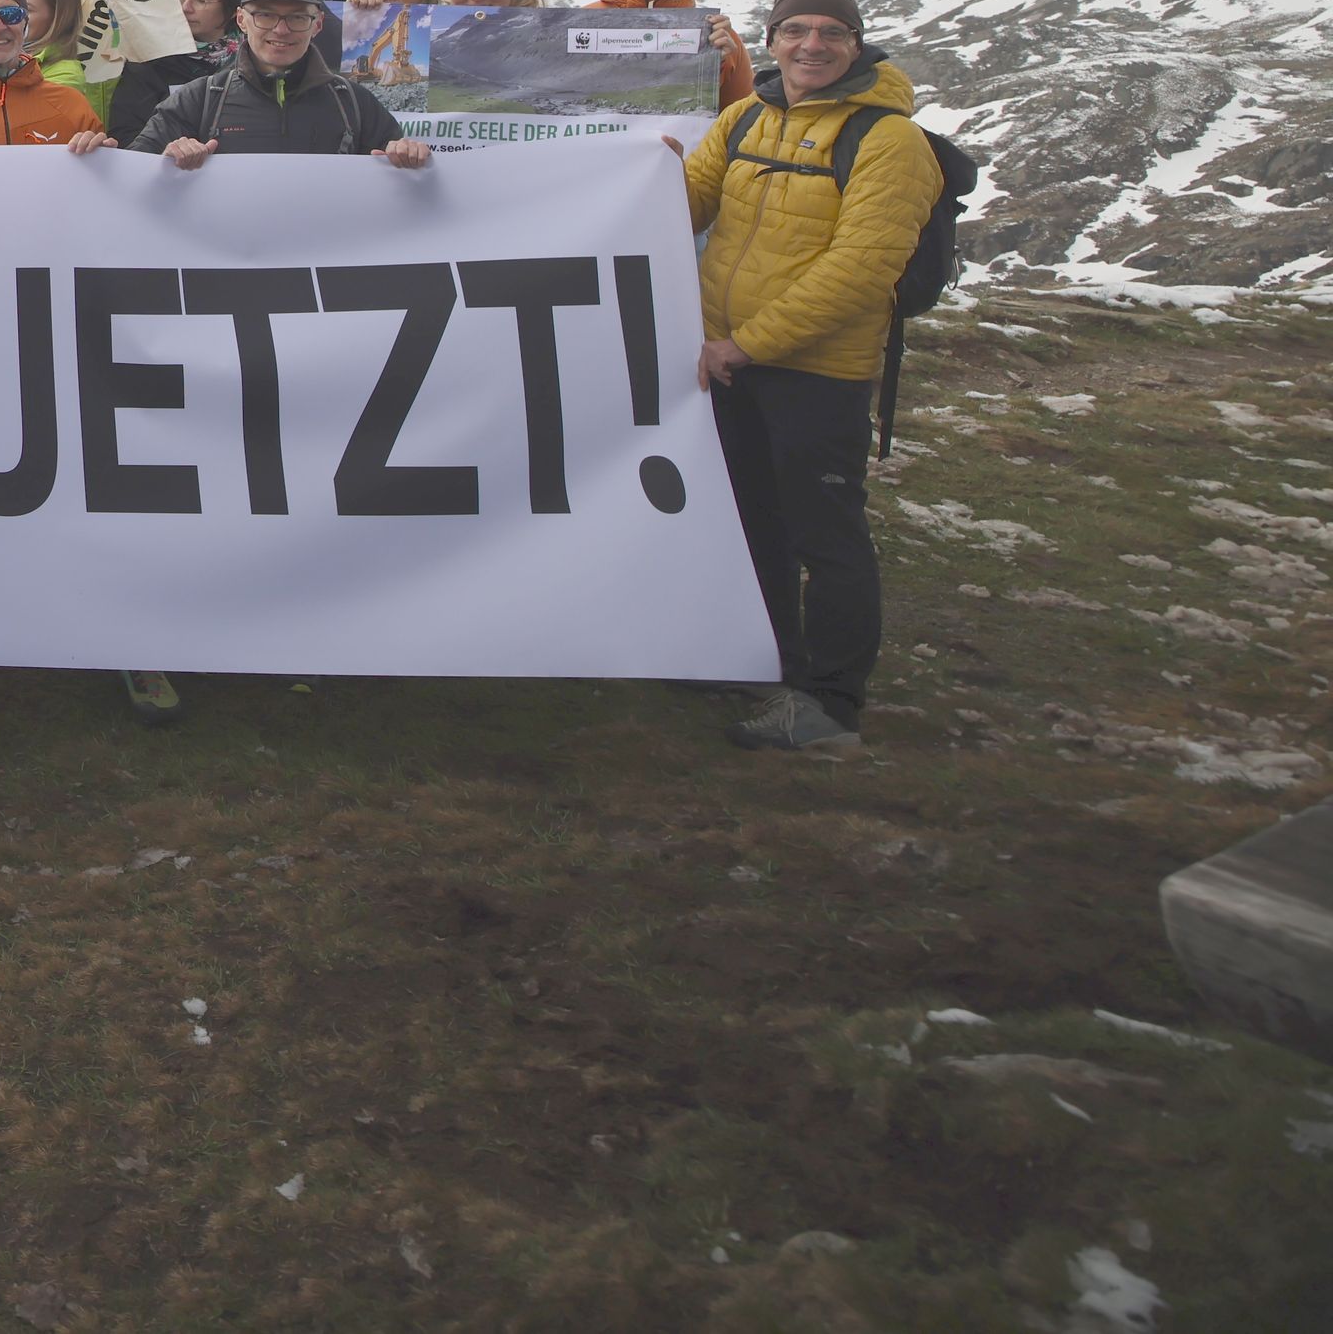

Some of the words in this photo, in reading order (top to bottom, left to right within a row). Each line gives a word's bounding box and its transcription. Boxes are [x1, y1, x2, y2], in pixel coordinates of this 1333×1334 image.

[436, 121, 463, 138] DIE
[468, 121, 518, 141] SEELE
[524, 123, 558, 142] DER
